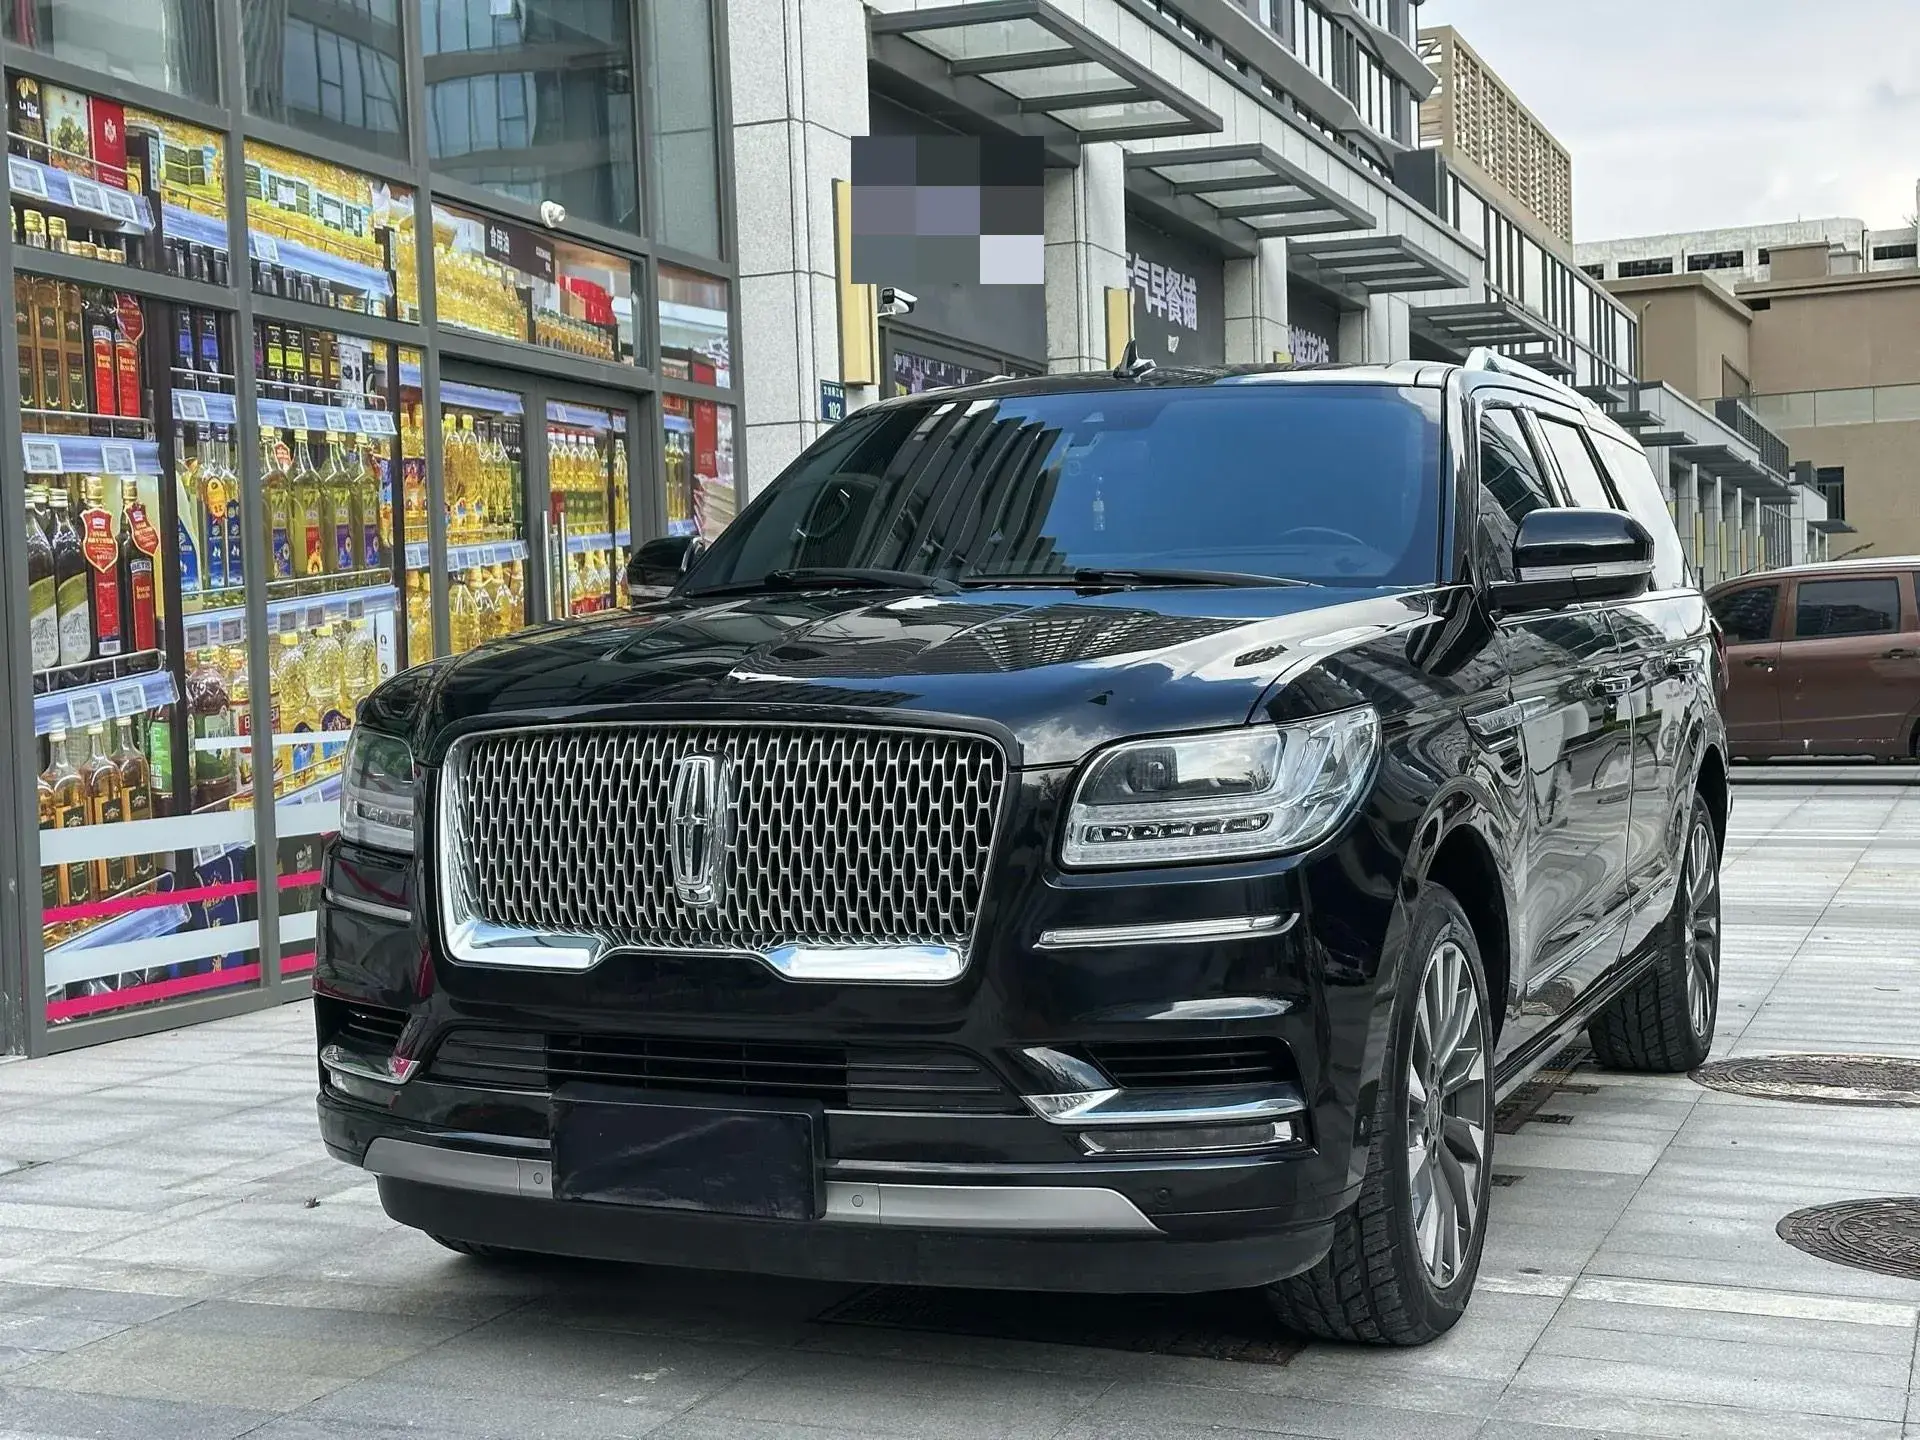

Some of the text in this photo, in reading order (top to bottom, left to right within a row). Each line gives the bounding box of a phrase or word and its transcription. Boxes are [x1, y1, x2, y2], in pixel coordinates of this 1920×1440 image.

[489, 225, 510, 255] 食用油
[828, 401, 841, 420] 102
